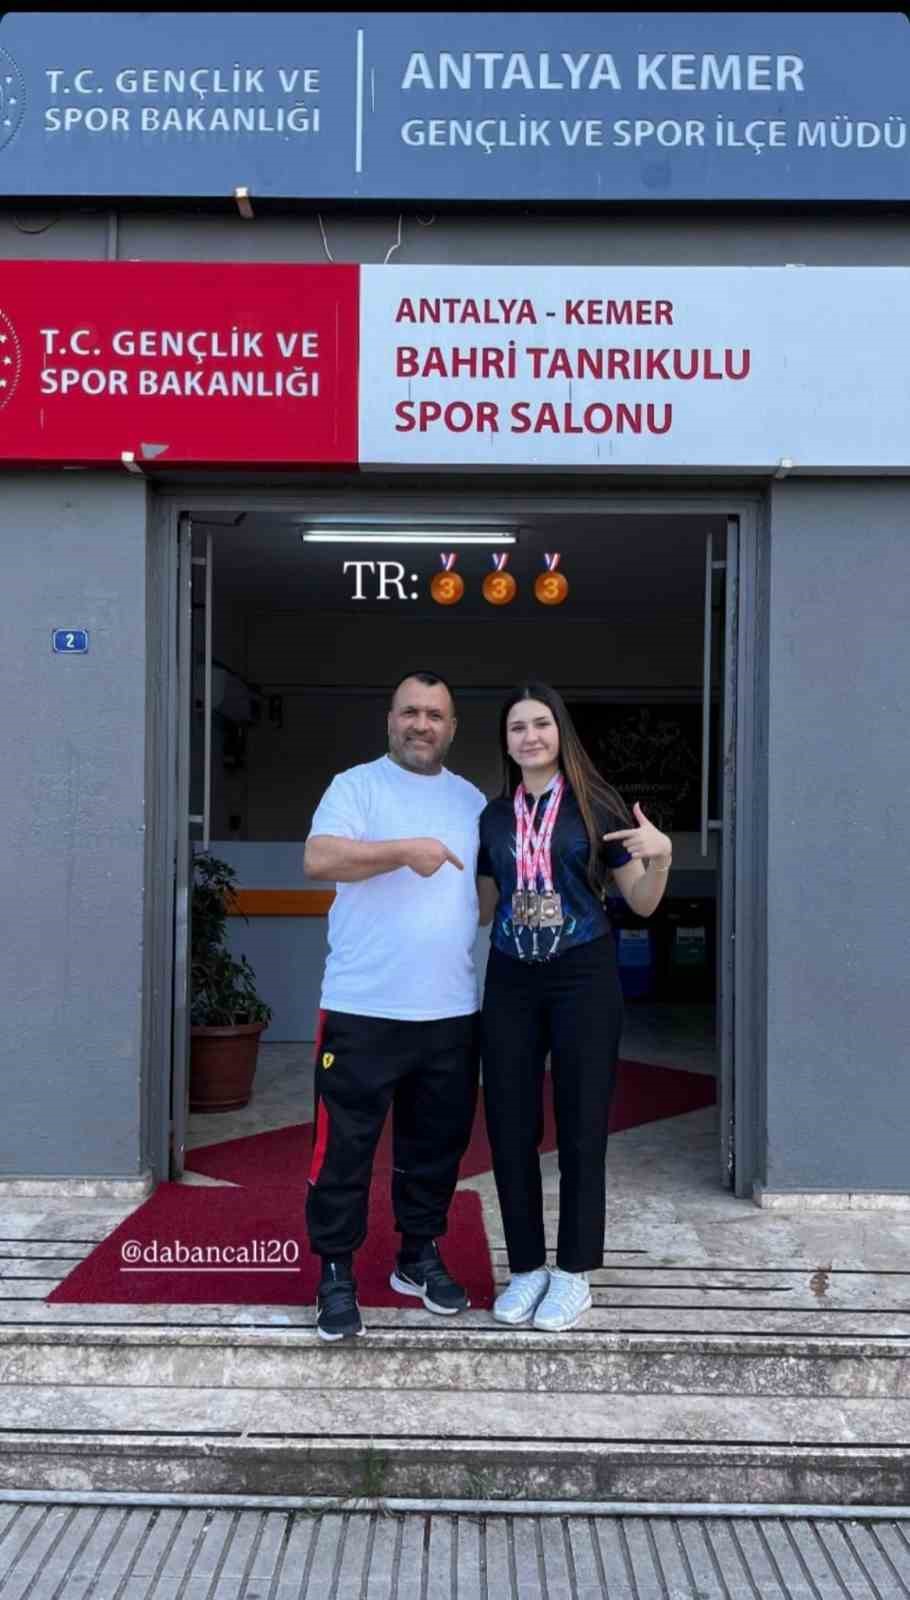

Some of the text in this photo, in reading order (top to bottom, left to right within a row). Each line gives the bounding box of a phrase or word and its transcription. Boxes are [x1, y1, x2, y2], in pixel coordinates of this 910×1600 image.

[46, 64, 319, 99] T.C. GENÇLİK VE
[402, 53, 804, 91] ANTALYA KEMER
[46, 103, 319, 131] SPOR BAKANLIĞI
[401, 114, 550, 153] GENÇLİK
[560, 121, 602, 146] VE
[614, 120, 704, 146] SPOR
[717, 115, 786, 154] İLÇE
[396, 298, 536, 324] ANTALYA
[566, 300, 672, 325] KEMER
[40, 327, 318, 364] T.C. GENÇLİK VE
[397, 341, 750, 380] BAHRİ TANRIKULU
[41, 367, 318, 396] SPOR BAKANLIĞI
[396, 401, 672, 434] SPOR SALONU
[65, 633, 75, 648] 2
